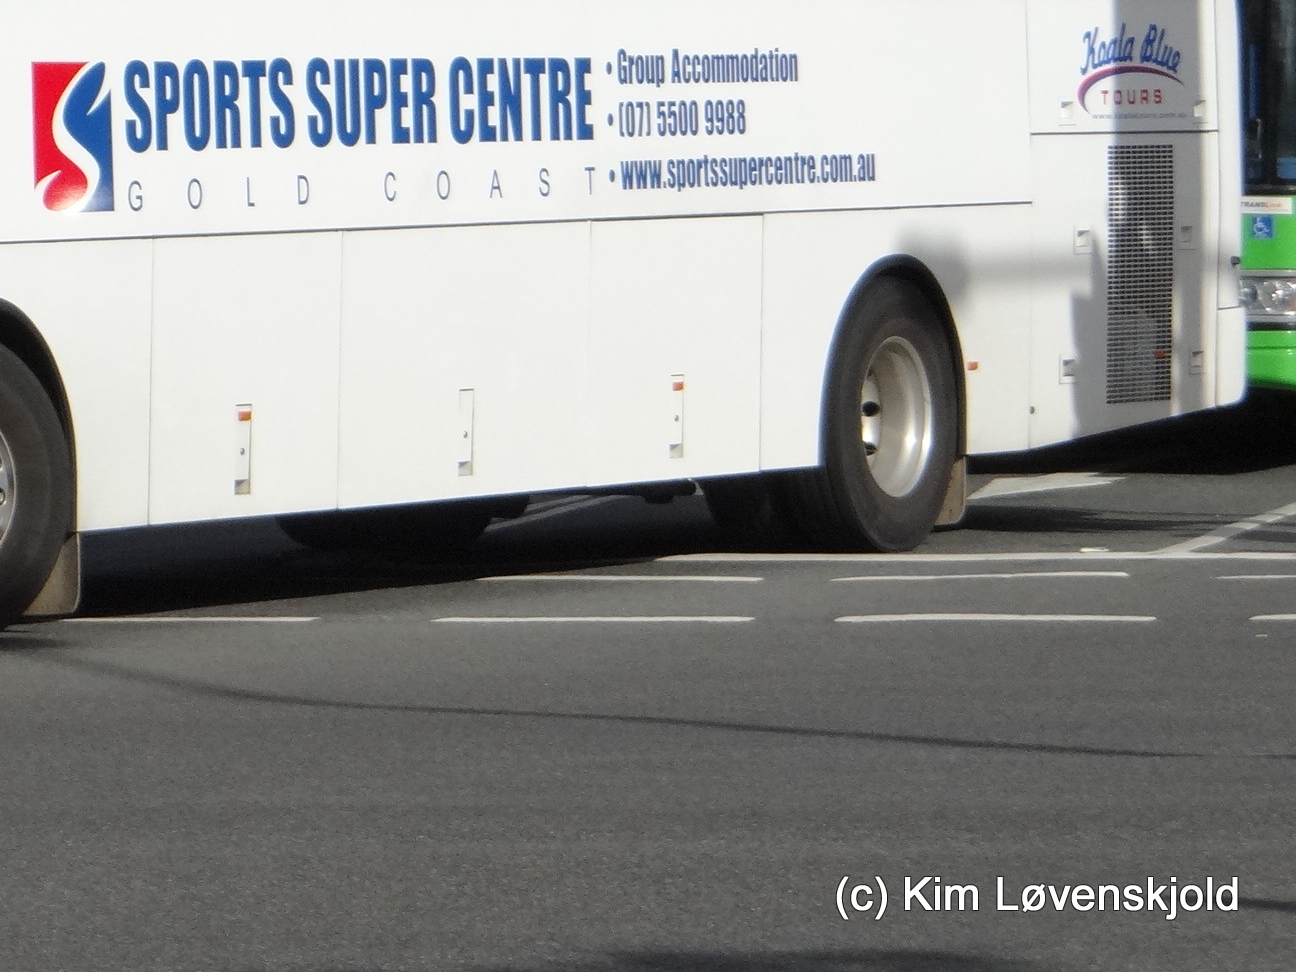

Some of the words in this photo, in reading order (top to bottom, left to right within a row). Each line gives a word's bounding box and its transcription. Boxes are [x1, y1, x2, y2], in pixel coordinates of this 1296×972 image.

[616, 48, 665, 88] Group
[671, 47, 799, 84] Accommodation
[1080, 21, 1135, 76] Koala
[1139, 23, 1181, 74] Blue
[123, 57, 296, 154] SPORTS
[306, 57, 438, 148] SUPER
[448, 55, 594, 145] CENTRE
[1100, 88, 1163, 105] TOURS
[618, 101, 652, 138] (07)
[656, 99, 699, 137] 5500
[704, 98, 747, 136] 9988
[127, 174, 310, 212] GOLD
[384, 167, 596, 202] COAST
[620, 151, 877, 192] www.sportssupercentre.com.au
